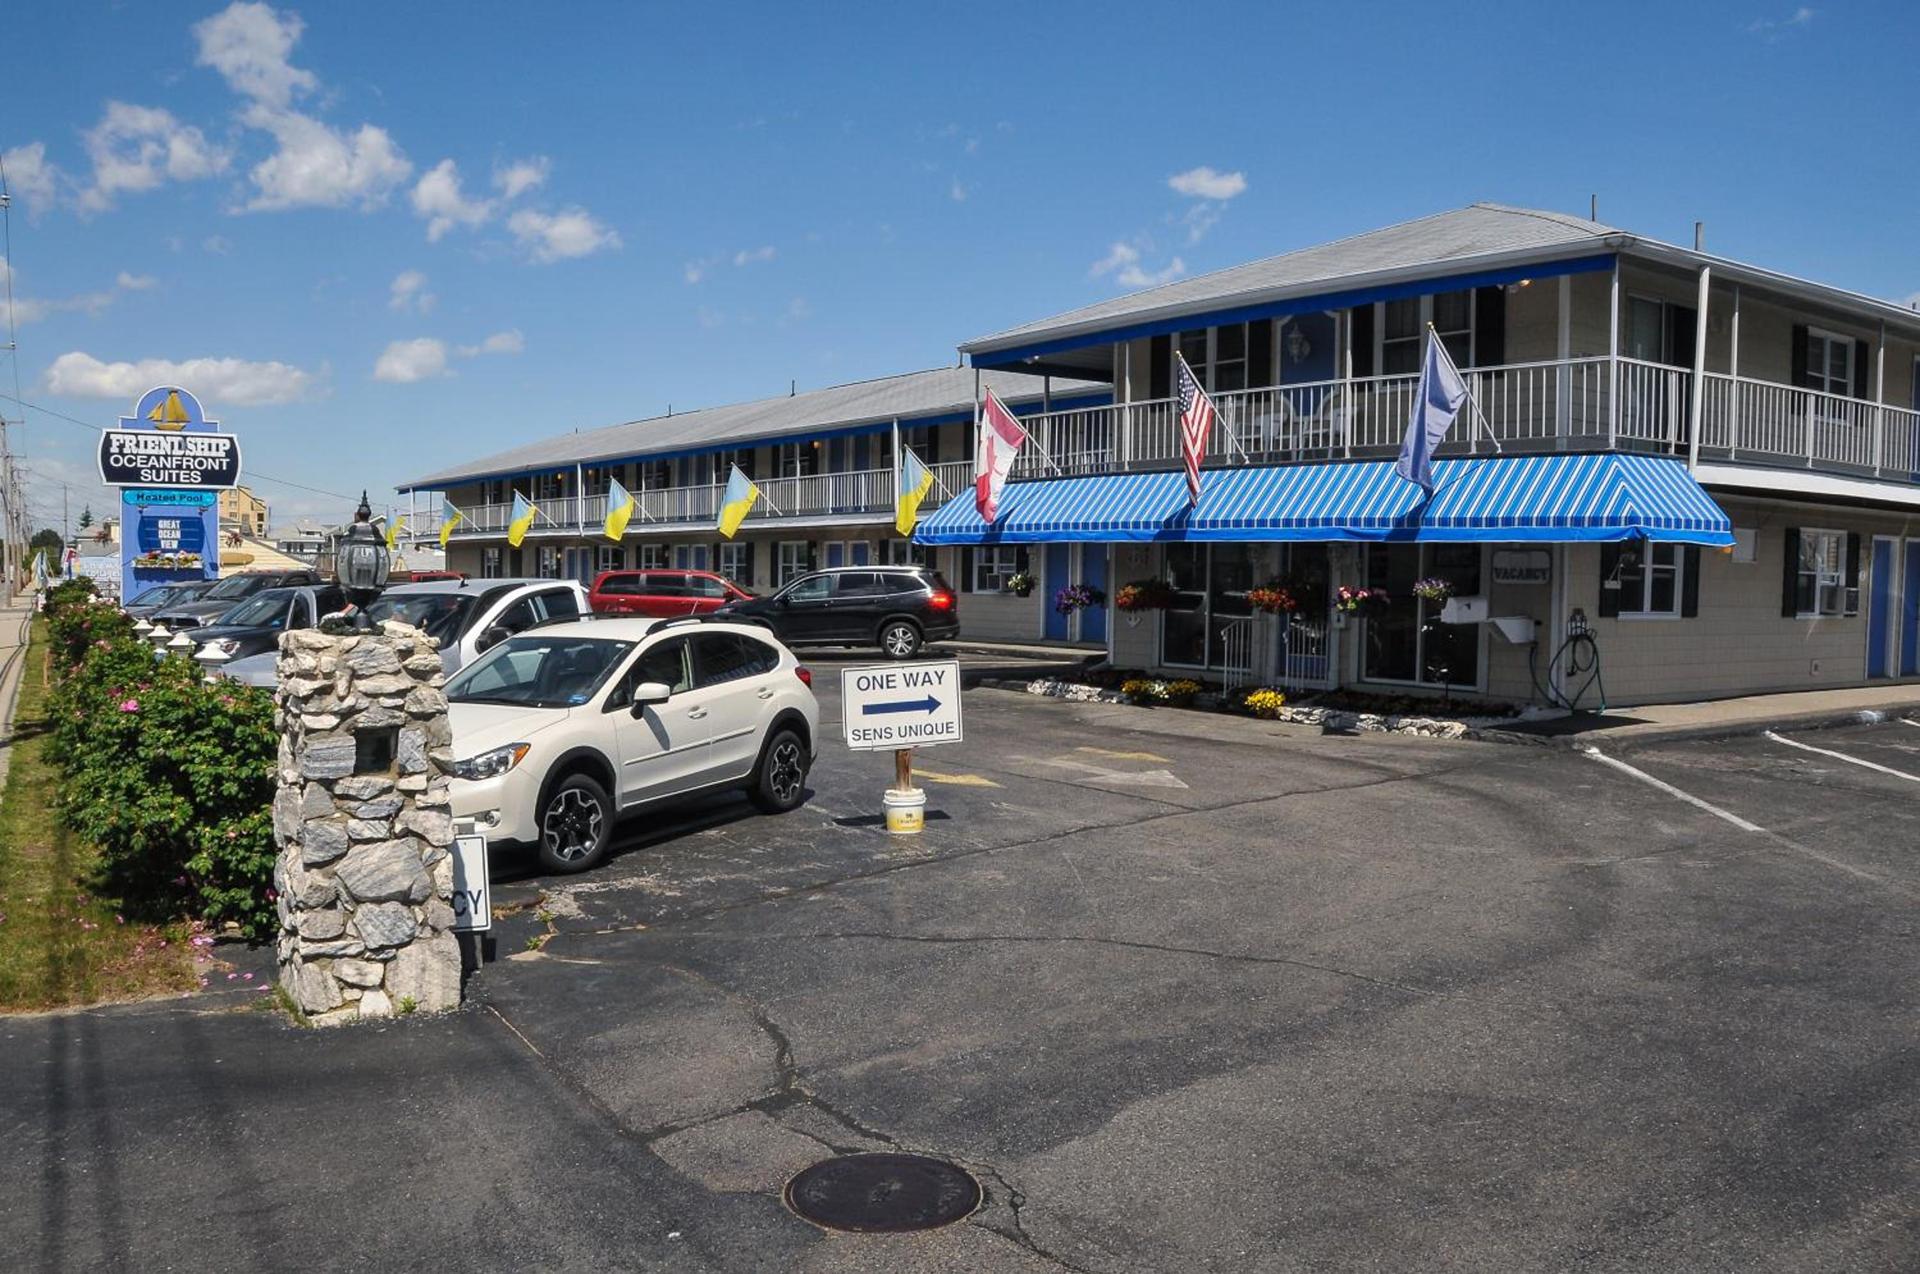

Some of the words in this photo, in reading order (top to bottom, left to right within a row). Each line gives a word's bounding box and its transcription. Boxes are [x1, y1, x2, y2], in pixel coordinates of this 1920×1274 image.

[110, 434, 231, 457] FRIENDSHIP
[110, 454, 231, 471] OCEANFRONT
[140, 469, 202, 483] SUITES
[136, 493, 176, 502] Heated
[179, 494, 203, 502] Pool
[158, 520, 181, 530] GREAT
[158, 530, 182, 539] OCEAN
[1494, 567, 1549, 580] VACANCY
[856, 674, 897, 692] ONE
[903, 671, 946, 688] WAY
[852, 726, 893, 741] SENS
[898, 721, 955, 739] UNIQUE
